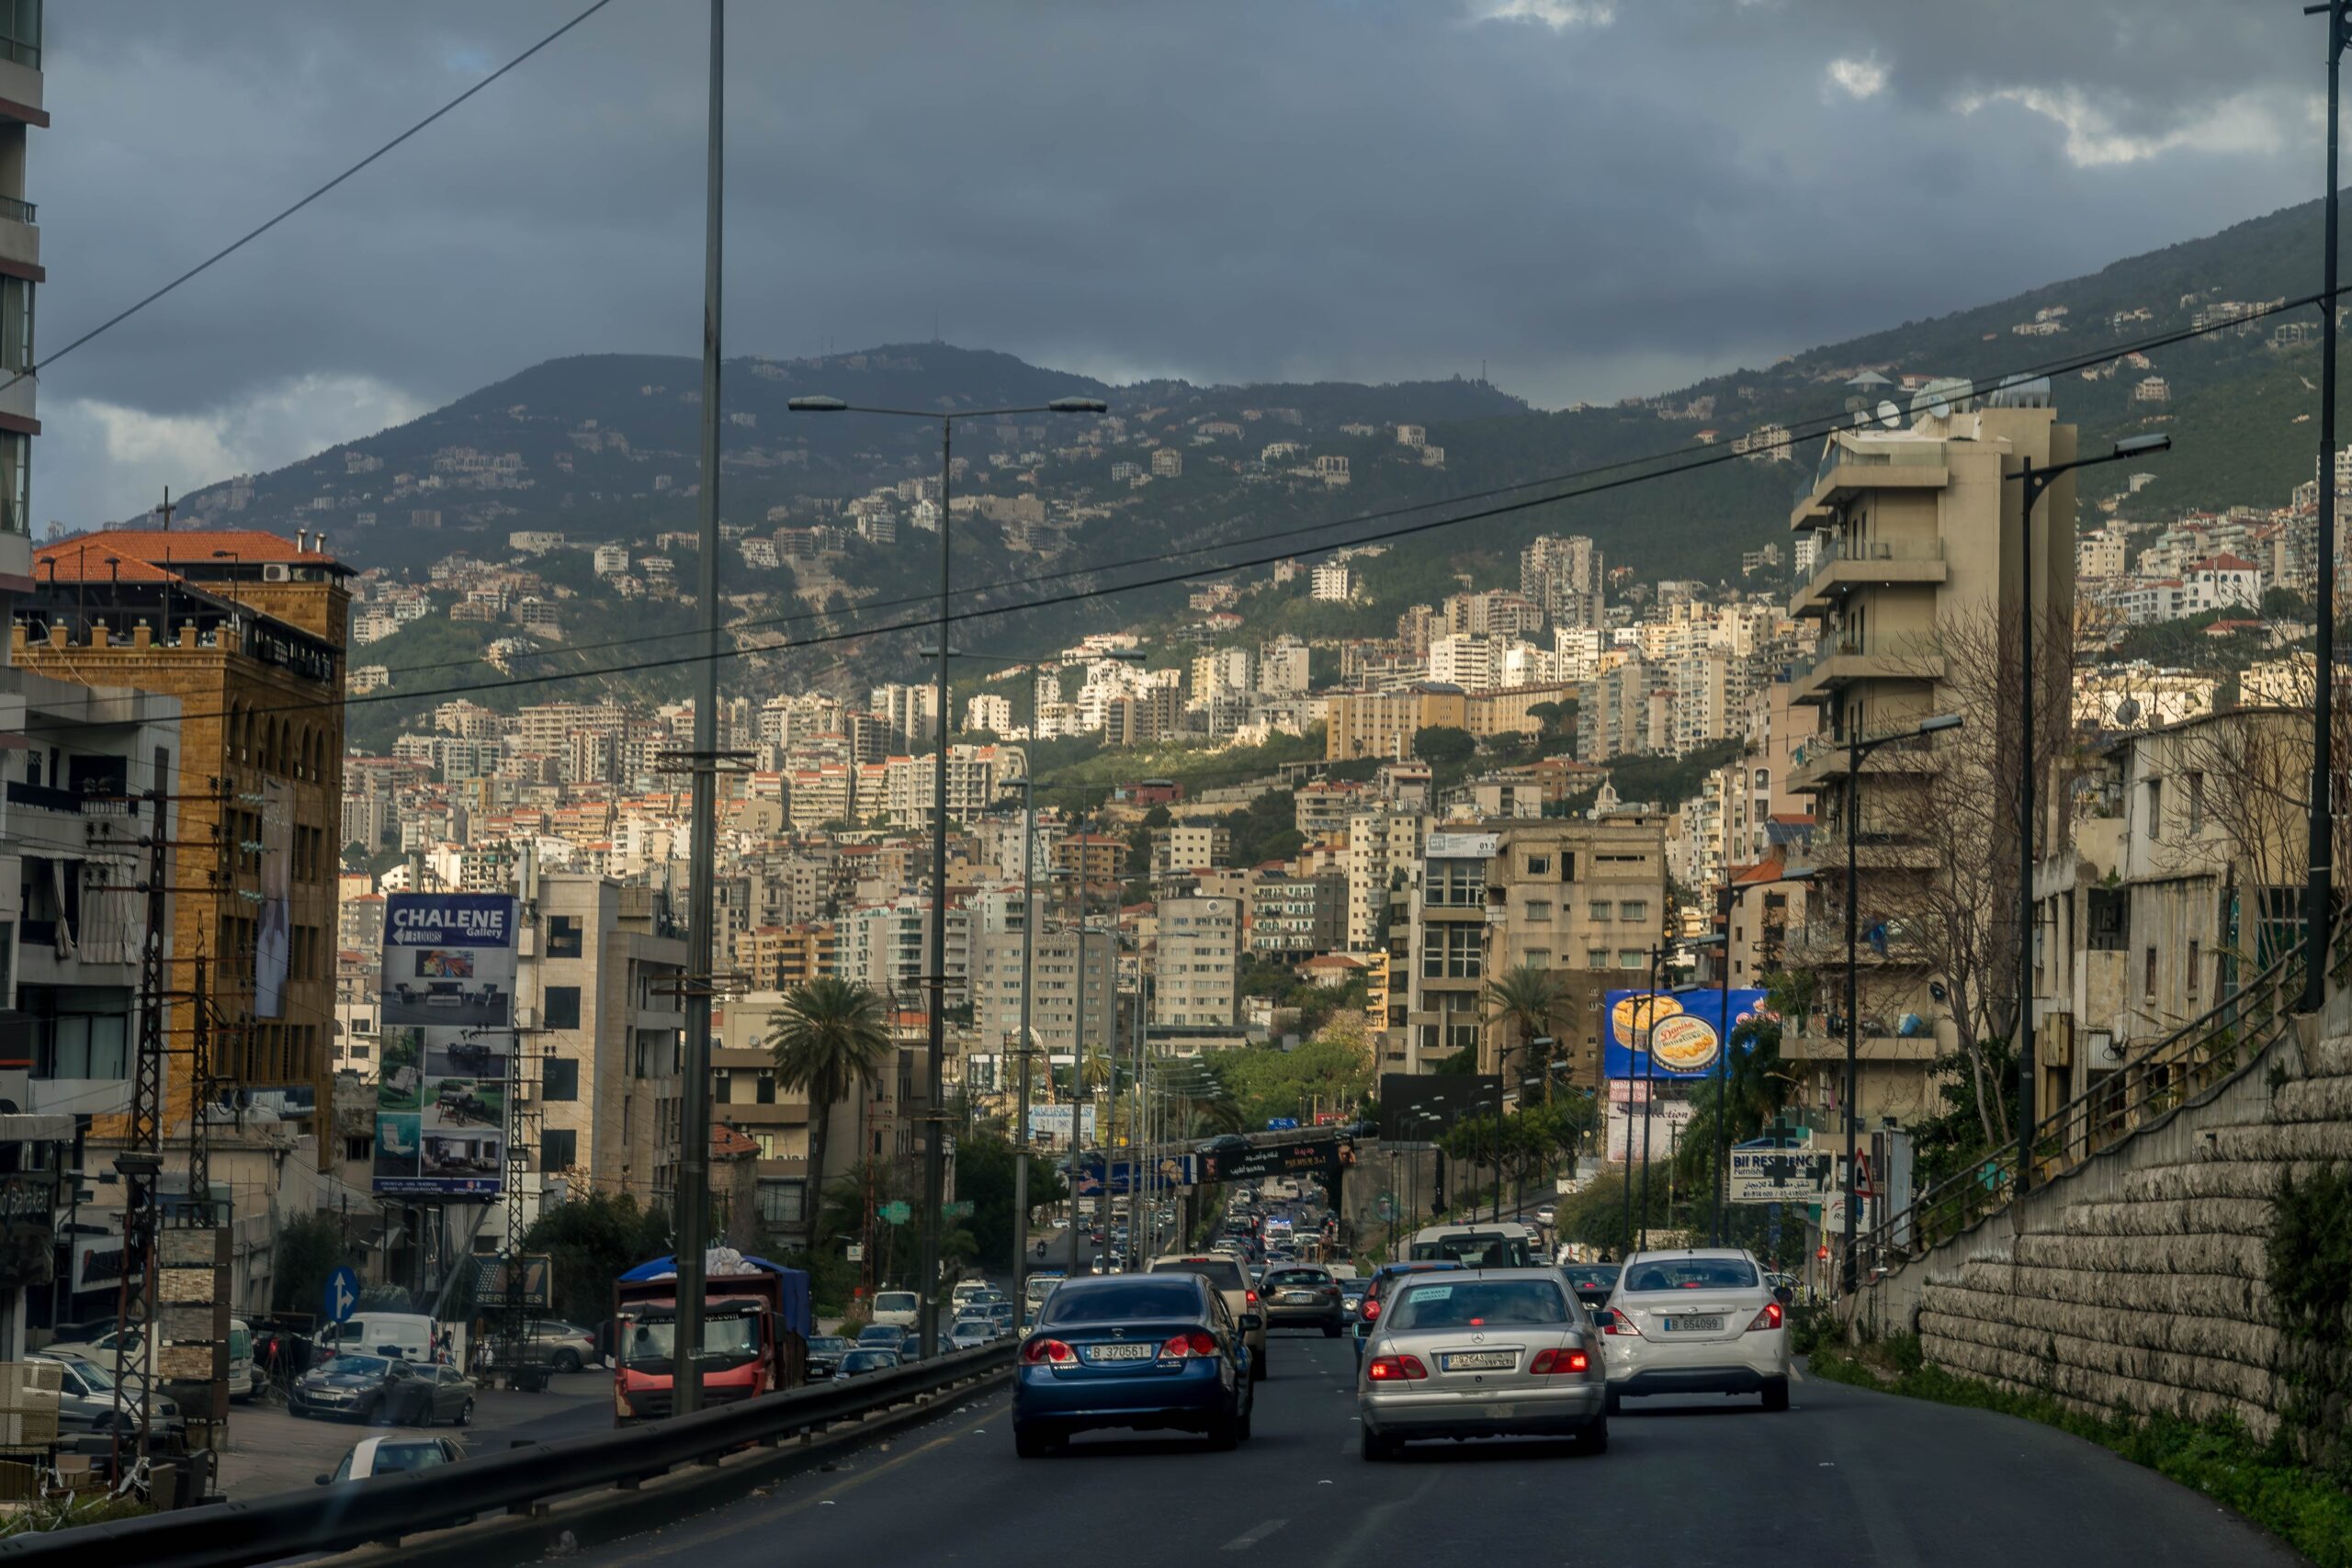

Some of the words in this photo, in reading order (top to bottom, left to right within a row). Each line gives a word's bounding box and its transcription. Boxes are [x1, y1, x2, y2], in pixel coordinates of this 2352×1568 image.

[393, 908, 503, 928] CHALENE
[466, 927, 503, 939] Gallery
[10, 1185, 48, 1214] Barakat
[1672, 1320, 1679, 1329] B
[1683, 1318, 1718, 1329] 654099
[1093, 1348, 1101, 1358] B
[1106, 1347, 1144, 1358] 370561
